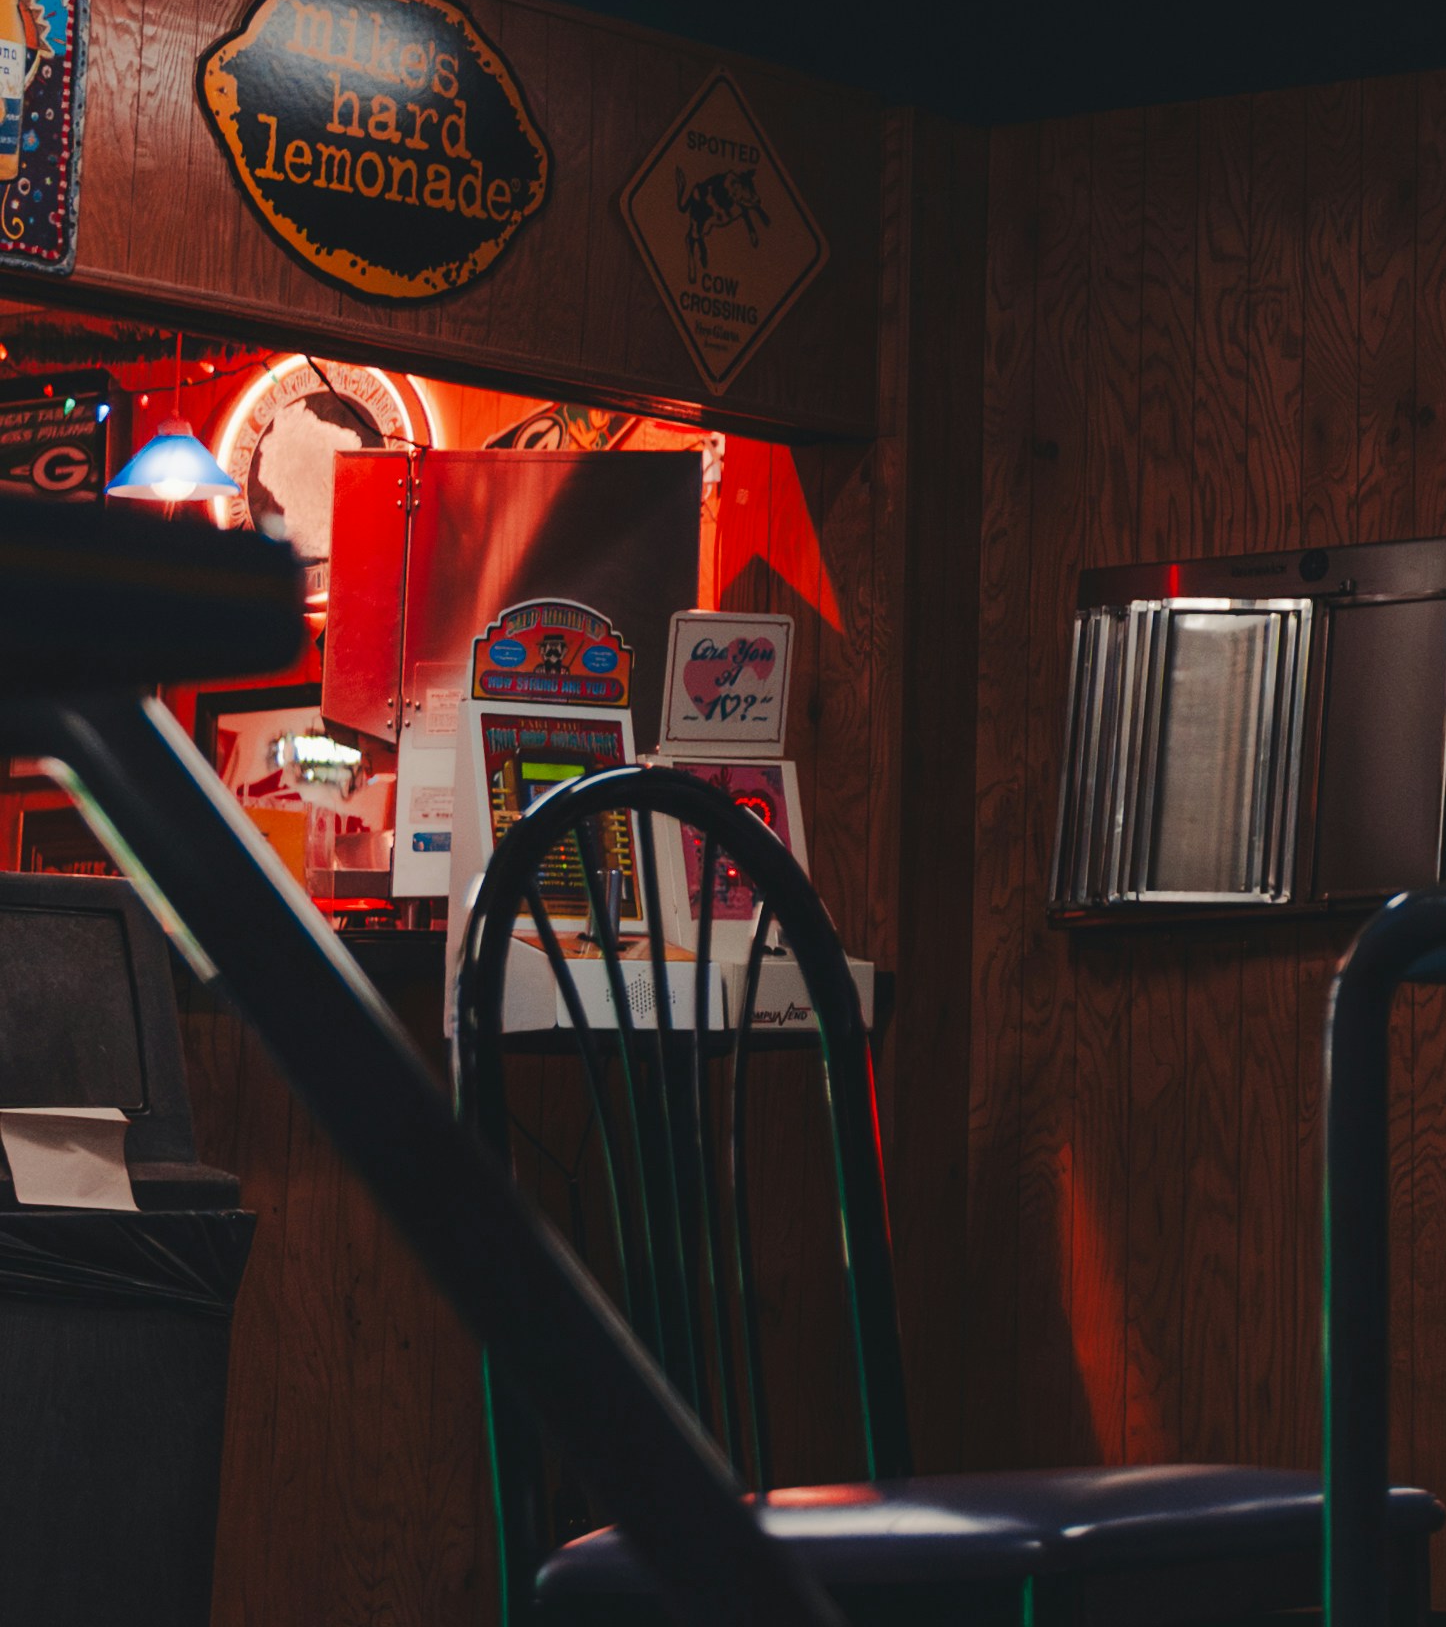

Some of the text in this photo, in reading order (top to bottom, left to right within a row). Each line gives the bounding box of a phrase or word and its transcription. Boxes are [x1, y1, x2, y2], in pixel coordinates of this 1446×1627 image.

[287, 0, 459, 100] mike's
[326, 73, 471, 159] hard
[687, 130, 760, 165] SPOTTED
[255, 112, 514, 221] lemonade
[702, 275, 739, 299] COW
[680, 291, 758, 325] CROSSING
[690, 637, 774, 666] Are You
